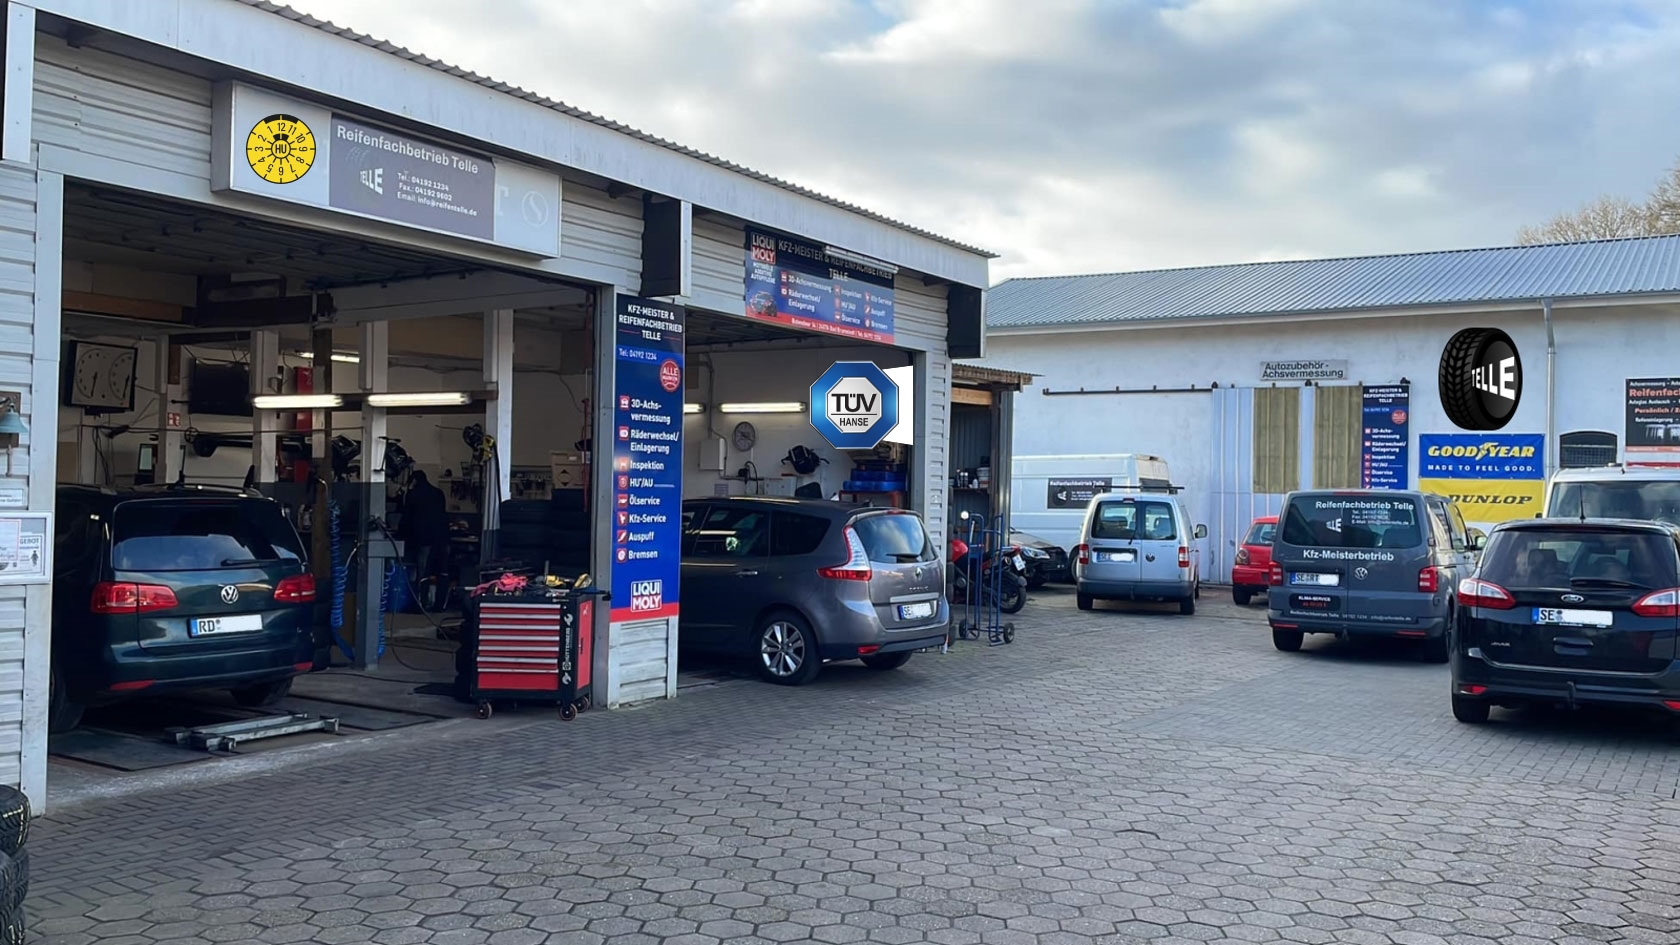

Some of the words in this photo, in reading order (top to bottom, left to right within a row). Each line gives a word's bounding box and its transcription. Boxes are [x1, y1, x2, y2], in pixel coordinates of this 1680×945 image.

[337, 125, 449, 166] Reifenfachbetrieb
[451, 156, 479, 174] Telle
[752, 234, 774, 250] LIQUI
[752, 247, 775, 262] MOLY
[627, 304, 669, 319] KFZ-MEISTER
[670, 312, 674, 320] &
[619, 315, 682, 333] REIFENFACHBETRIEB
[642, 330, 661, 341] TELLE
[664, 367, 678, 376] ALLE
[1262, 369, 1344, 378] Achsvermessung
[631, 399, 662, 410] 3D-Achs-
[631, 413, 671, 425] vermessung
[630, 429, 680, 441] Räderwechsel/
[630, 442, 670, 454] Einlagerung
[1428, 443, 1535, 459] GOODYEAR
[630, 460, 664, 470] Inspektion
[630, 494, 660, 505] Ölservice
[1315, 501, 1391, 509] Reifenfachbetrieb
[1393, 502, 1414, 510] Telle
[629, 513, 666, 523] Kfz-Service
[628, 531, 654, 542] Auspuff
[628, 550, 658, 560] Bremsen
[1303, 549, 1394, 561] Kfz-Meisterbetrieb
[632, 582, 660, 595] LIQUI
[632, 595, 661, 611] MOLY
[1540, 609, 1555, 621] SE
[199, 620, 215, 632] RD
